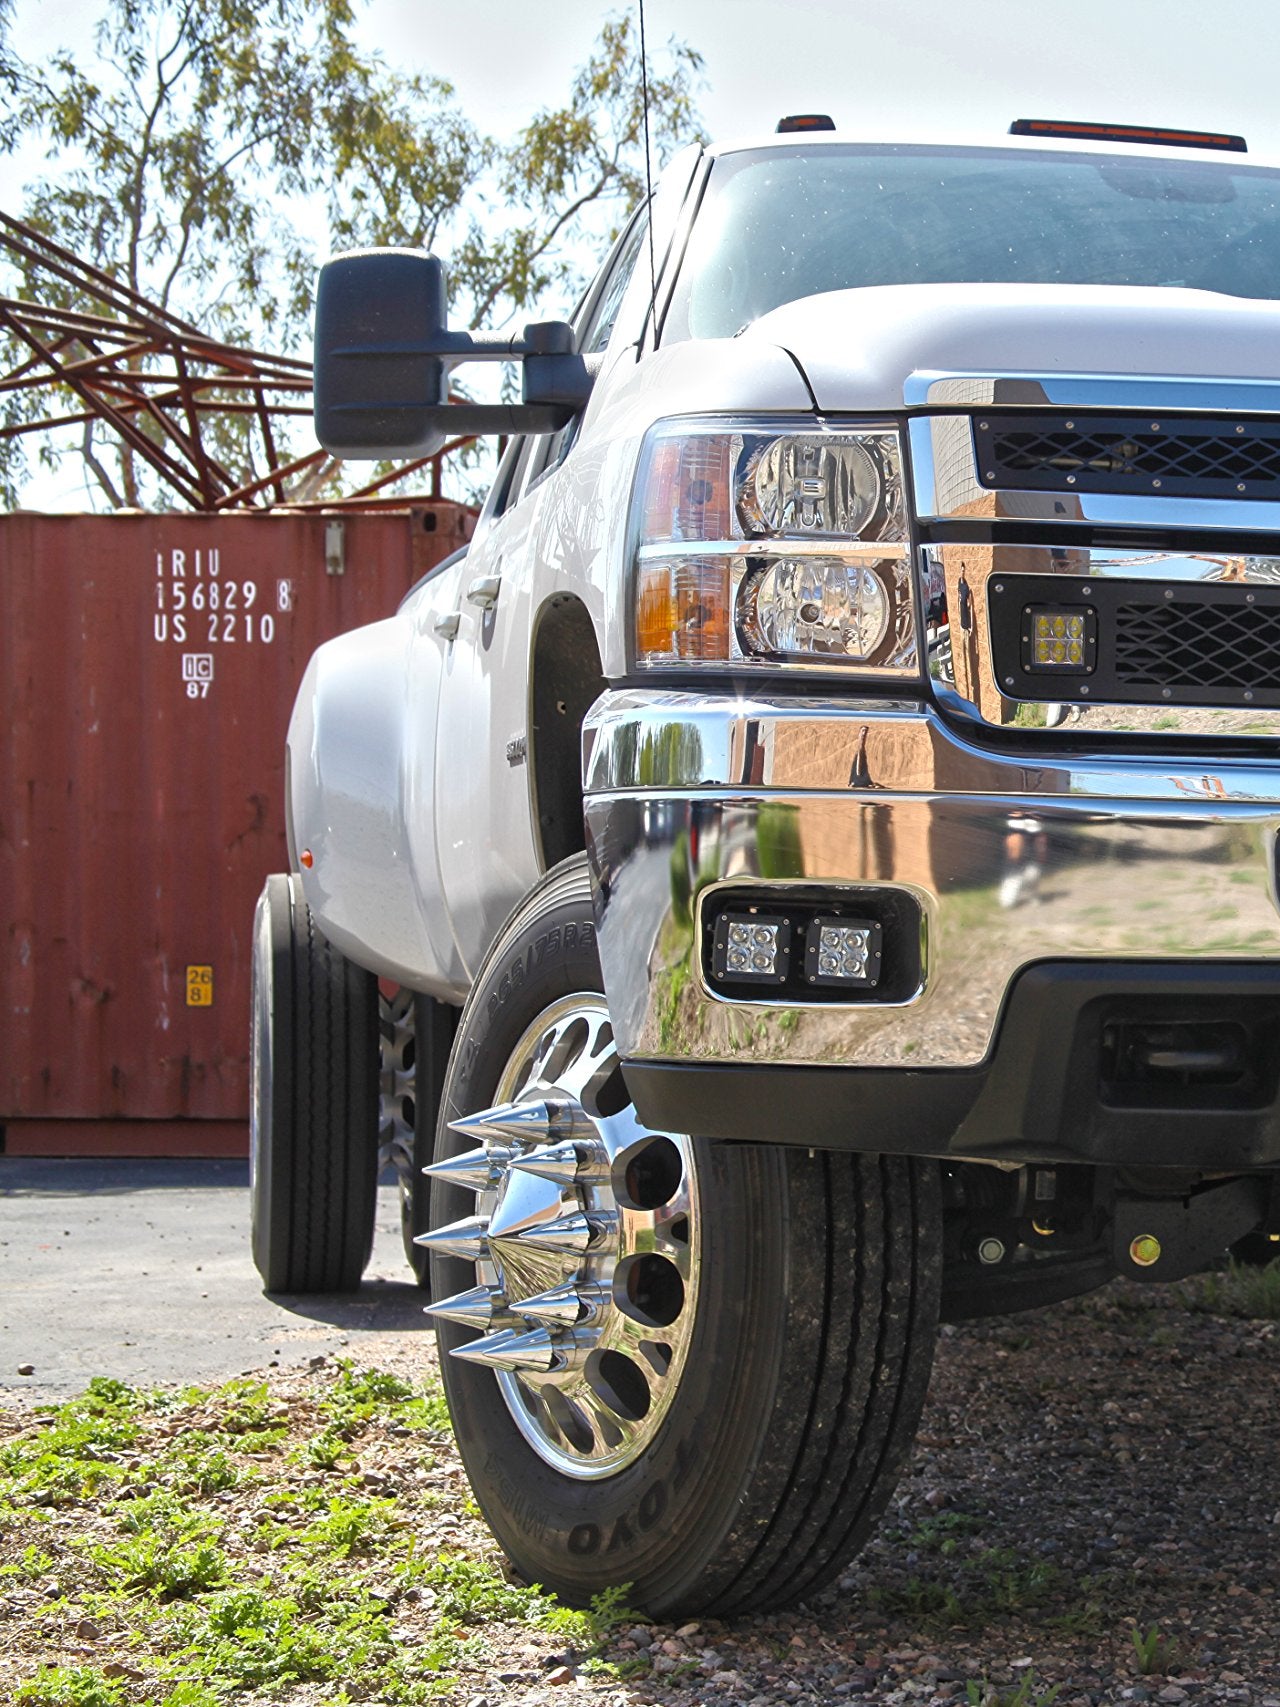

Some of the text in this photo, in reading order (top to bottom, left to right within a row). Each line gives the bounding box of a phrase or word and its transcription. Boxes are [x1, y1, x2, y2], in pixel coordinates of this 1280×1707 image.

[156, 580, 290, 610] 156829 8
[154, 613, 274, 642] US 2210
[186, 681, 209, 698] 87
